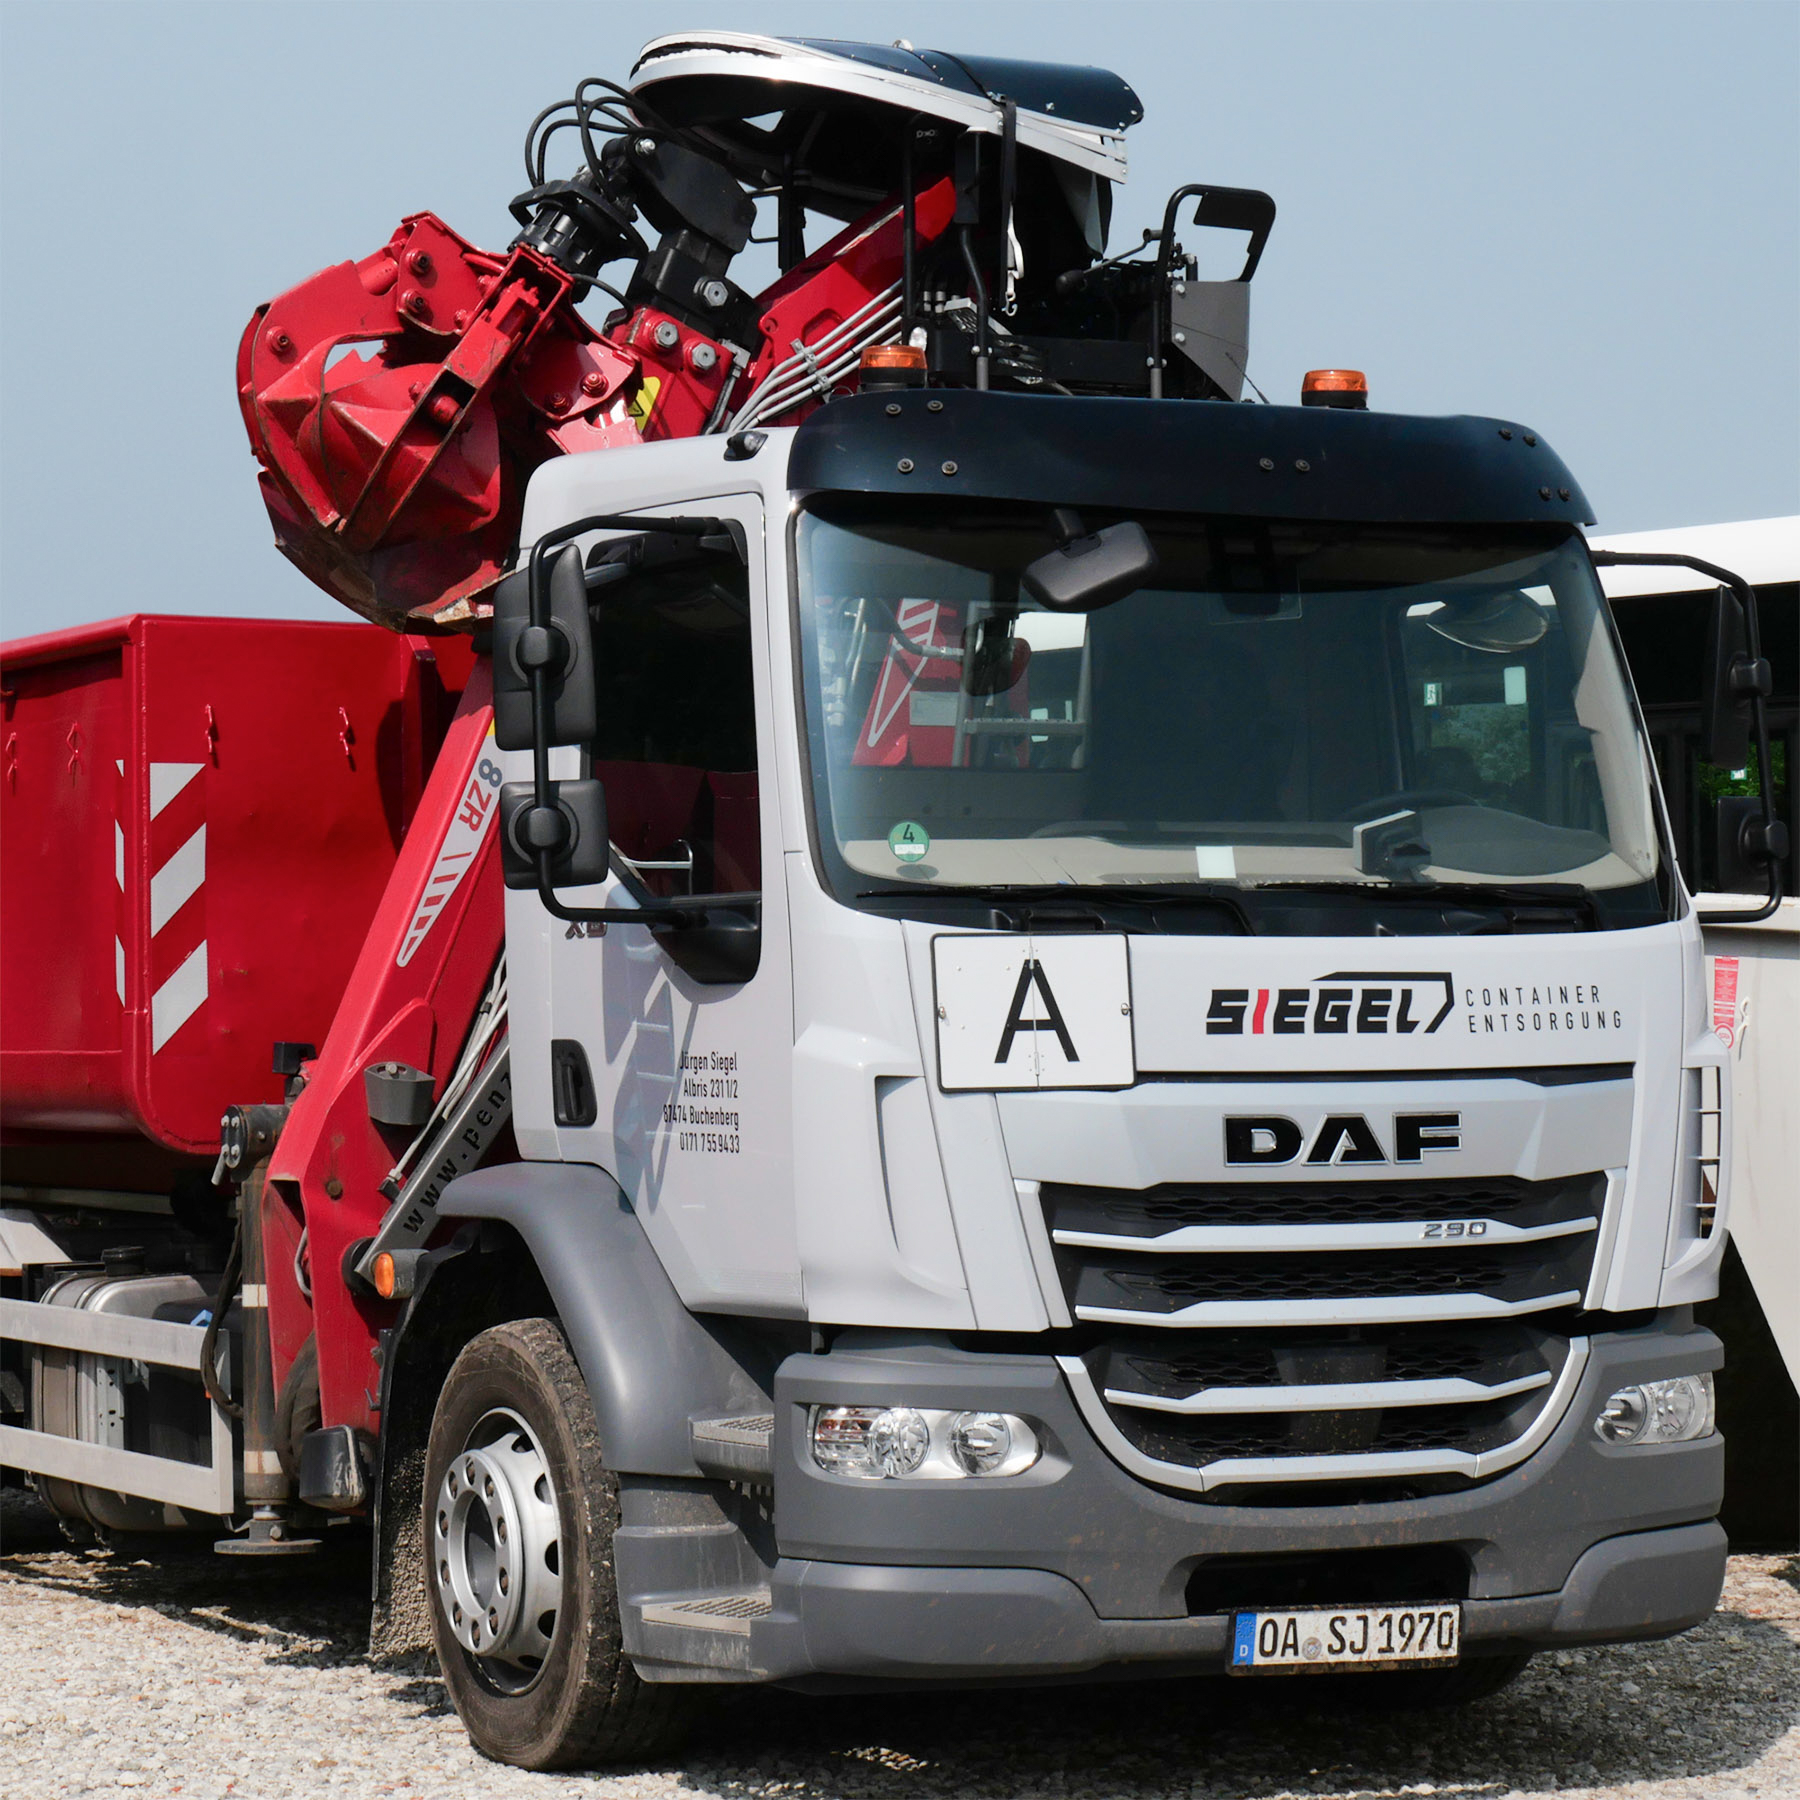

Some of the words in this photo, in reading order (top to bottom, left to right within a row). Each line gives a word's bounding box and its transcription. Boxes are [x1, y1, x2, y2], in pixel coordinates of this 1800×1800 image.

[903, 824, 915, 843] 4
[1465, 985, 1601, 1007] CONTAINER
[994, 959, 1081, 1063] A
[1206, 988, 1421, 1035] SIEGEL
[1468, 1010, 1622, 1034] ENTSORGUNG
[680, 1050, 708, 1075] Jürgen
[710, 1051, 737, 1076] Siegel
[683, 1078, 708, 1097] Albris
[662, 1104, 687, 1124] 87474
[689, 1105, 740, 1132] Buchenberg
[679, 1132, 699, 1152] 0171
[1223, 1111, 1463, 1168] DAF
[1420, 1221, 1487, 1240] 290
[1259, 1618, 1299, 1657] OA
